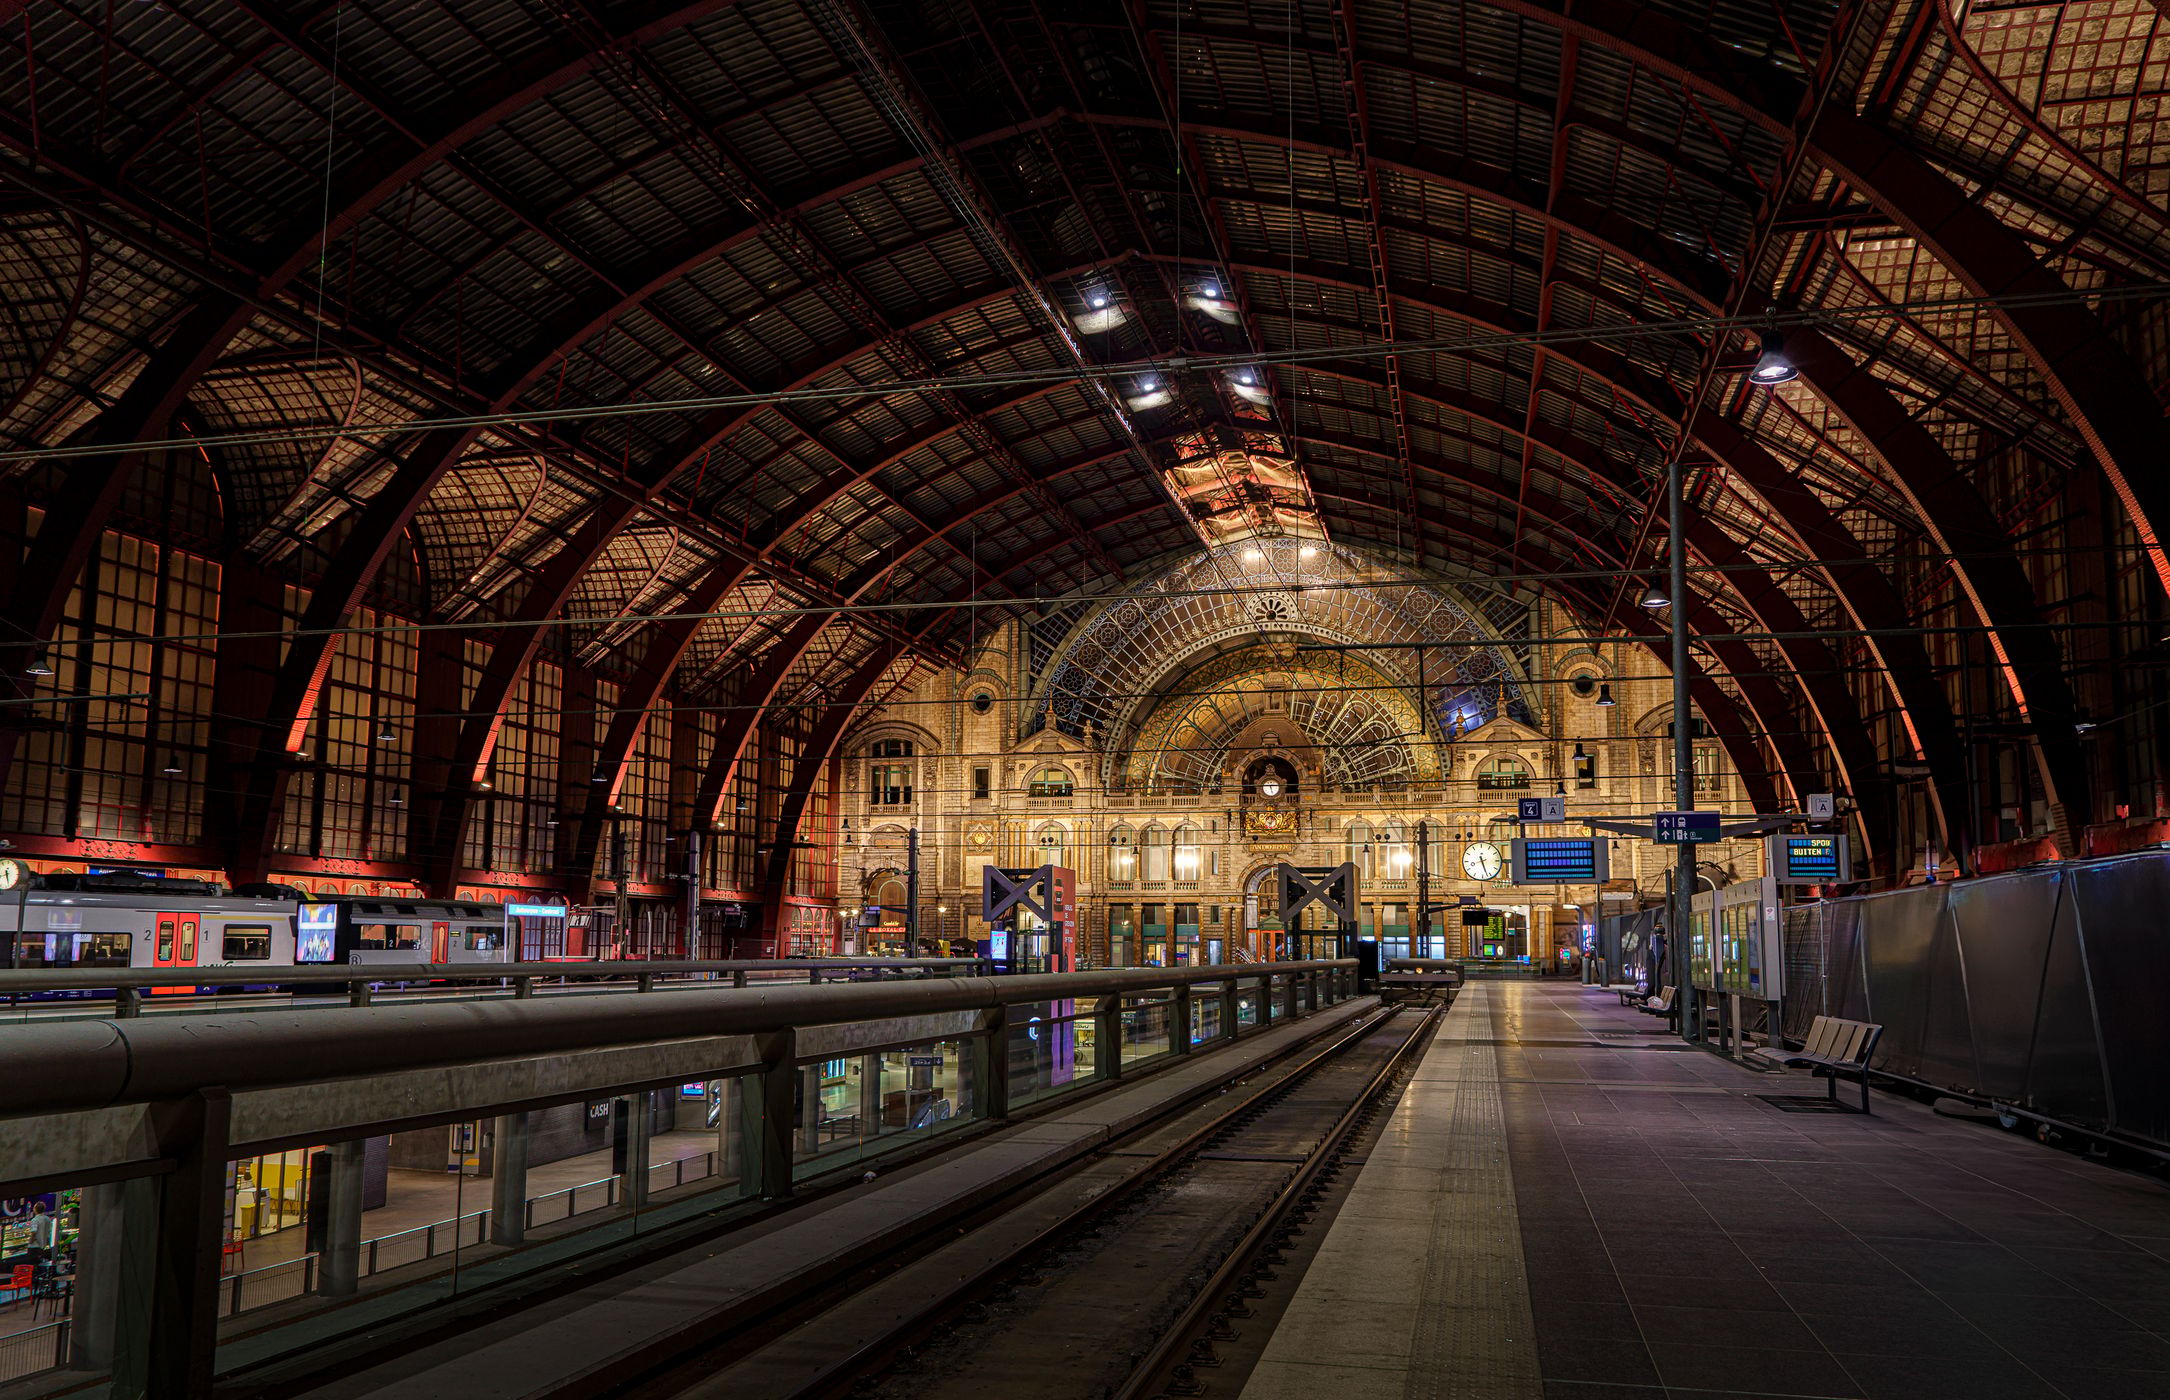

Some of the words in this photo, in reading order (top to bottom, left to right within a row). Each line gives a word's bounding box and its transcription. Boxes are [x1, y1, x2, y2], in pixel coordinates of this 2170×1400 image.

[1527, 807, 1534, 815] 4
[1550, 807, 1556, 815] A
[1819, 804, 1827, 812] A
[144, 929, 152, 941] 2
[203, 930, 209, 941] 1
[388, 939, 394, 948] 2
[590, 1103, 609, 1118] CASH
